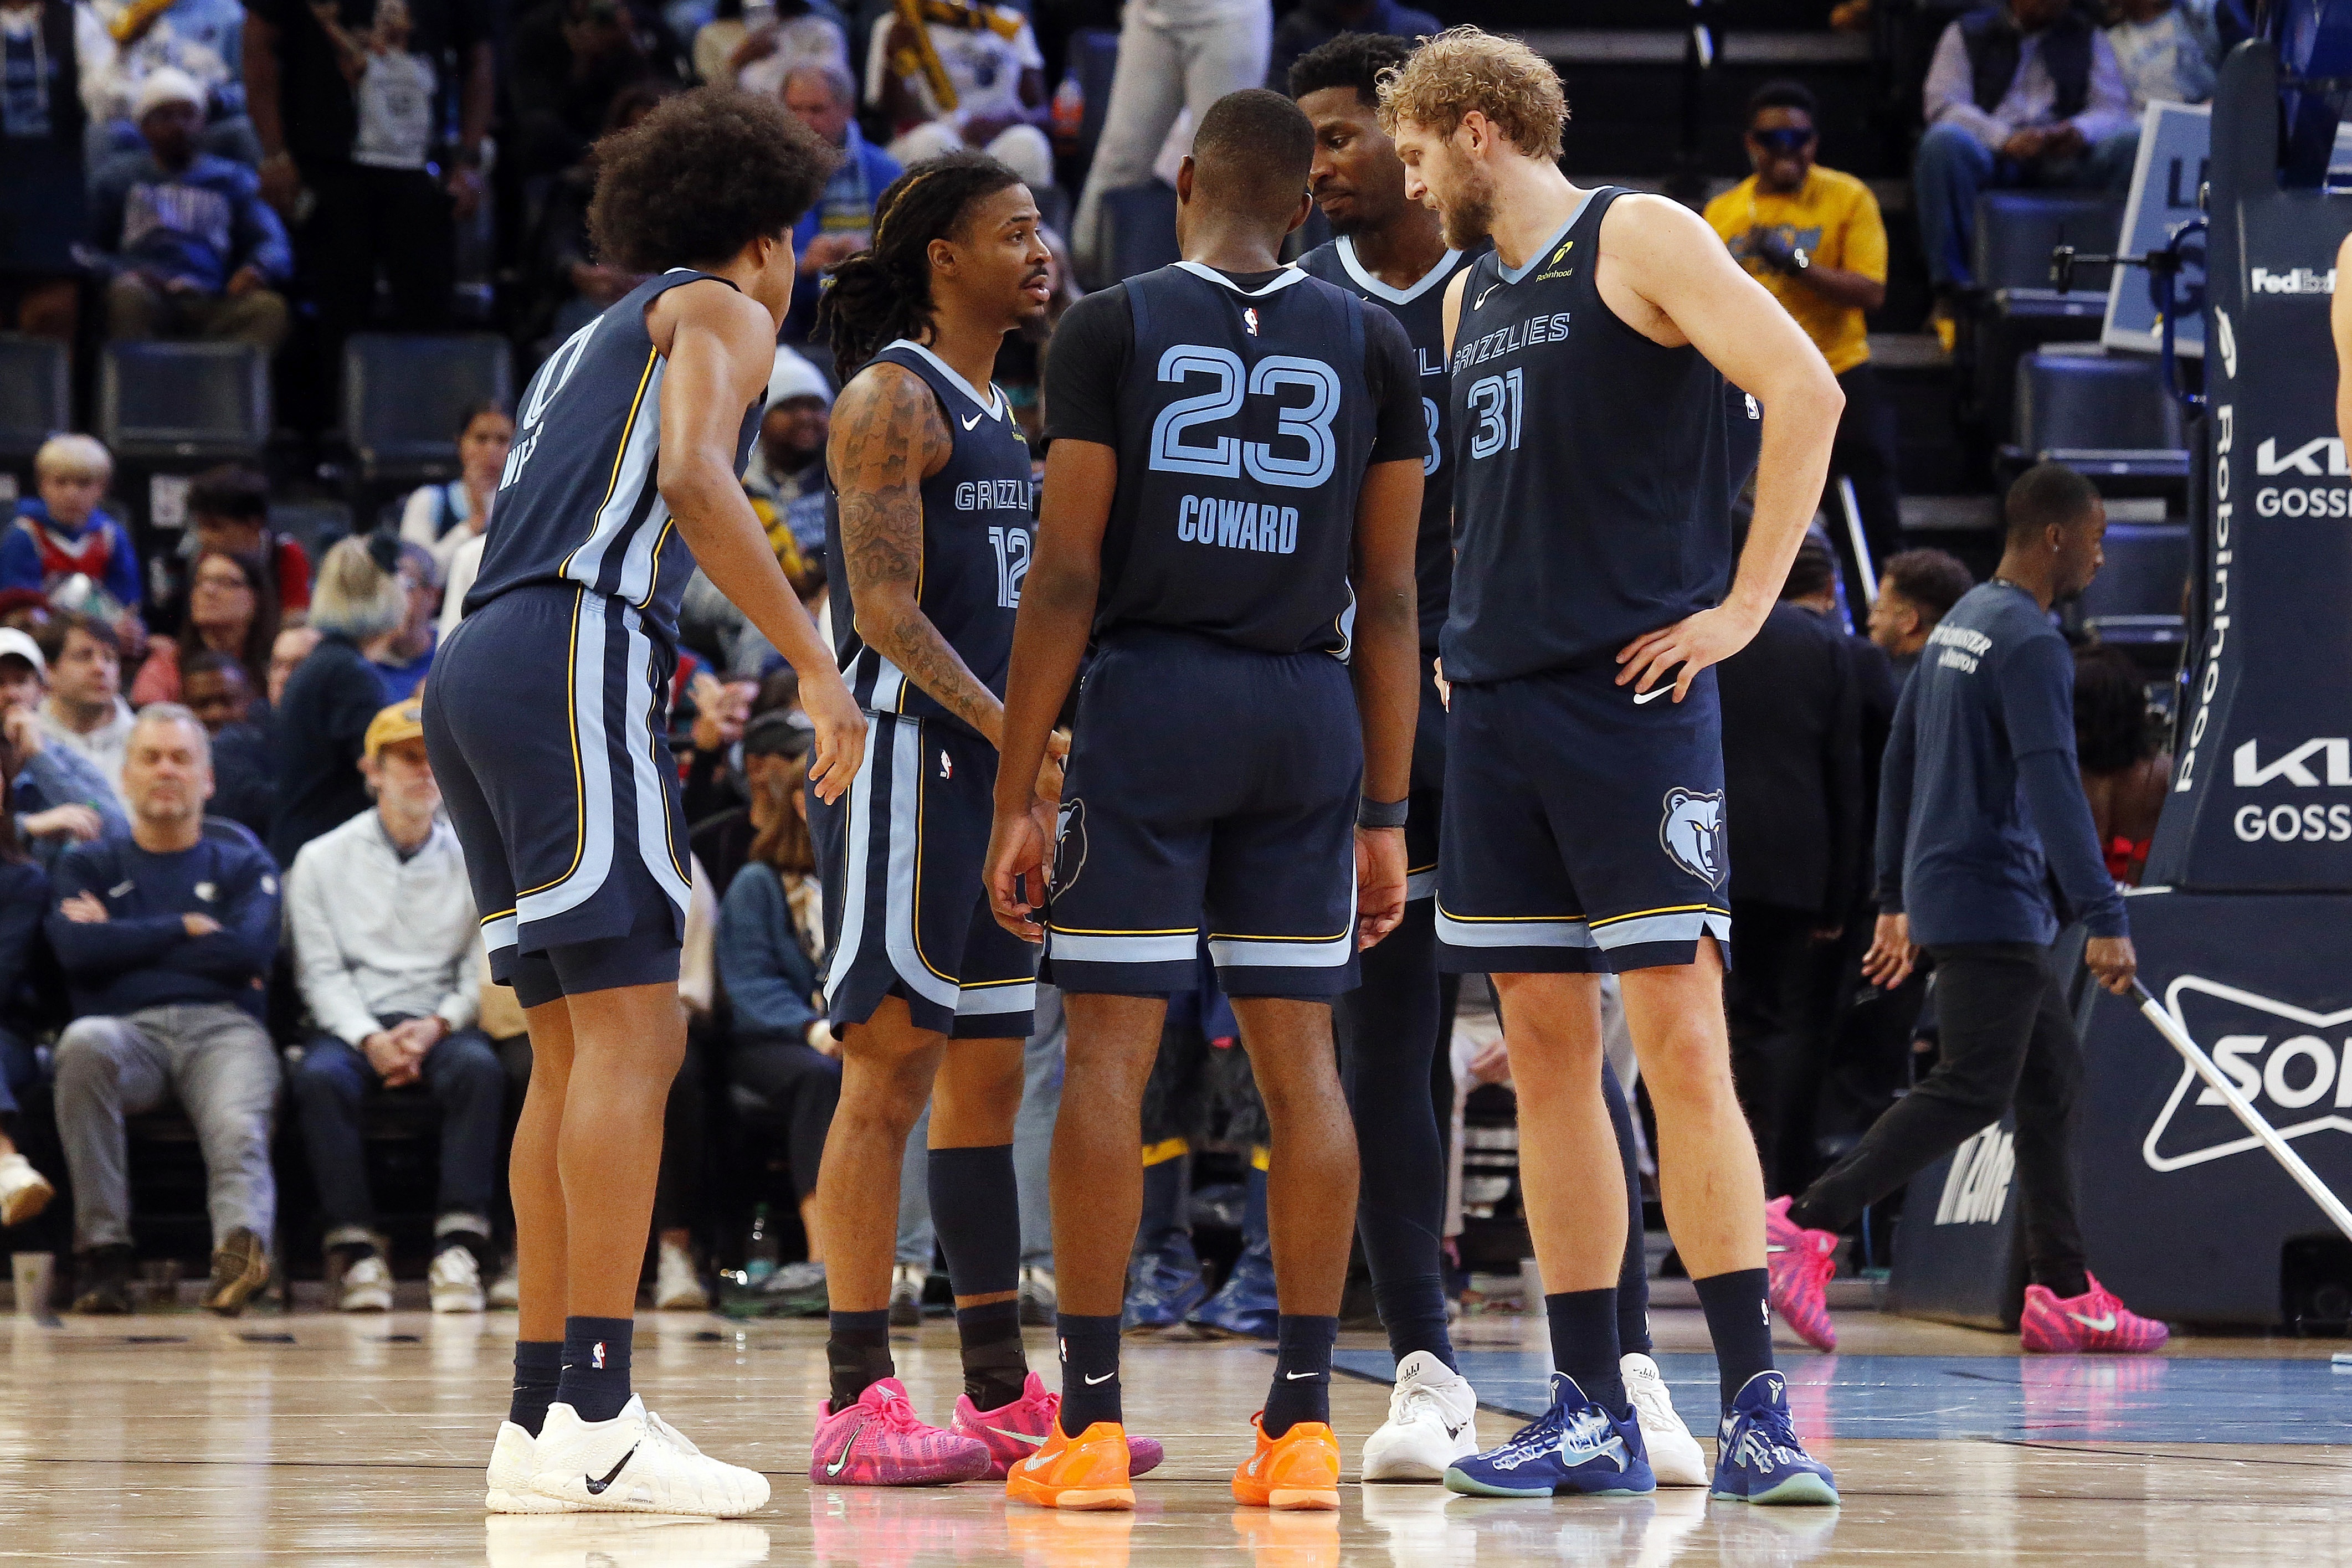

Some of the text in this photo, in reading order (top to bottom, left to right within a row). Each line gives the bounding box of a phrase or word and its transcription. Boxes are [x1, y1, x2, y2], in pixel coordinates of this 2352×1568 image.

[1535, 268, 1573, 282] Robinhood
[1451, 312, 1571, 379] GRIZZLIES
[1148, 344, 1341, 489] 23
[1467, 366, 1523, 460] 31
[2256, 436, 2352, 476] KI
[955, 479, 1033, 512] GRIZZLI
[1178, 495, 1299, 554] COWARD
[2256, 487, 2352, 518] GOSS
[988, 526, 1031, 609] 12
[2175, 404, 2234, 793] Robinhood
[2233, 738, 2352, 788] KI
